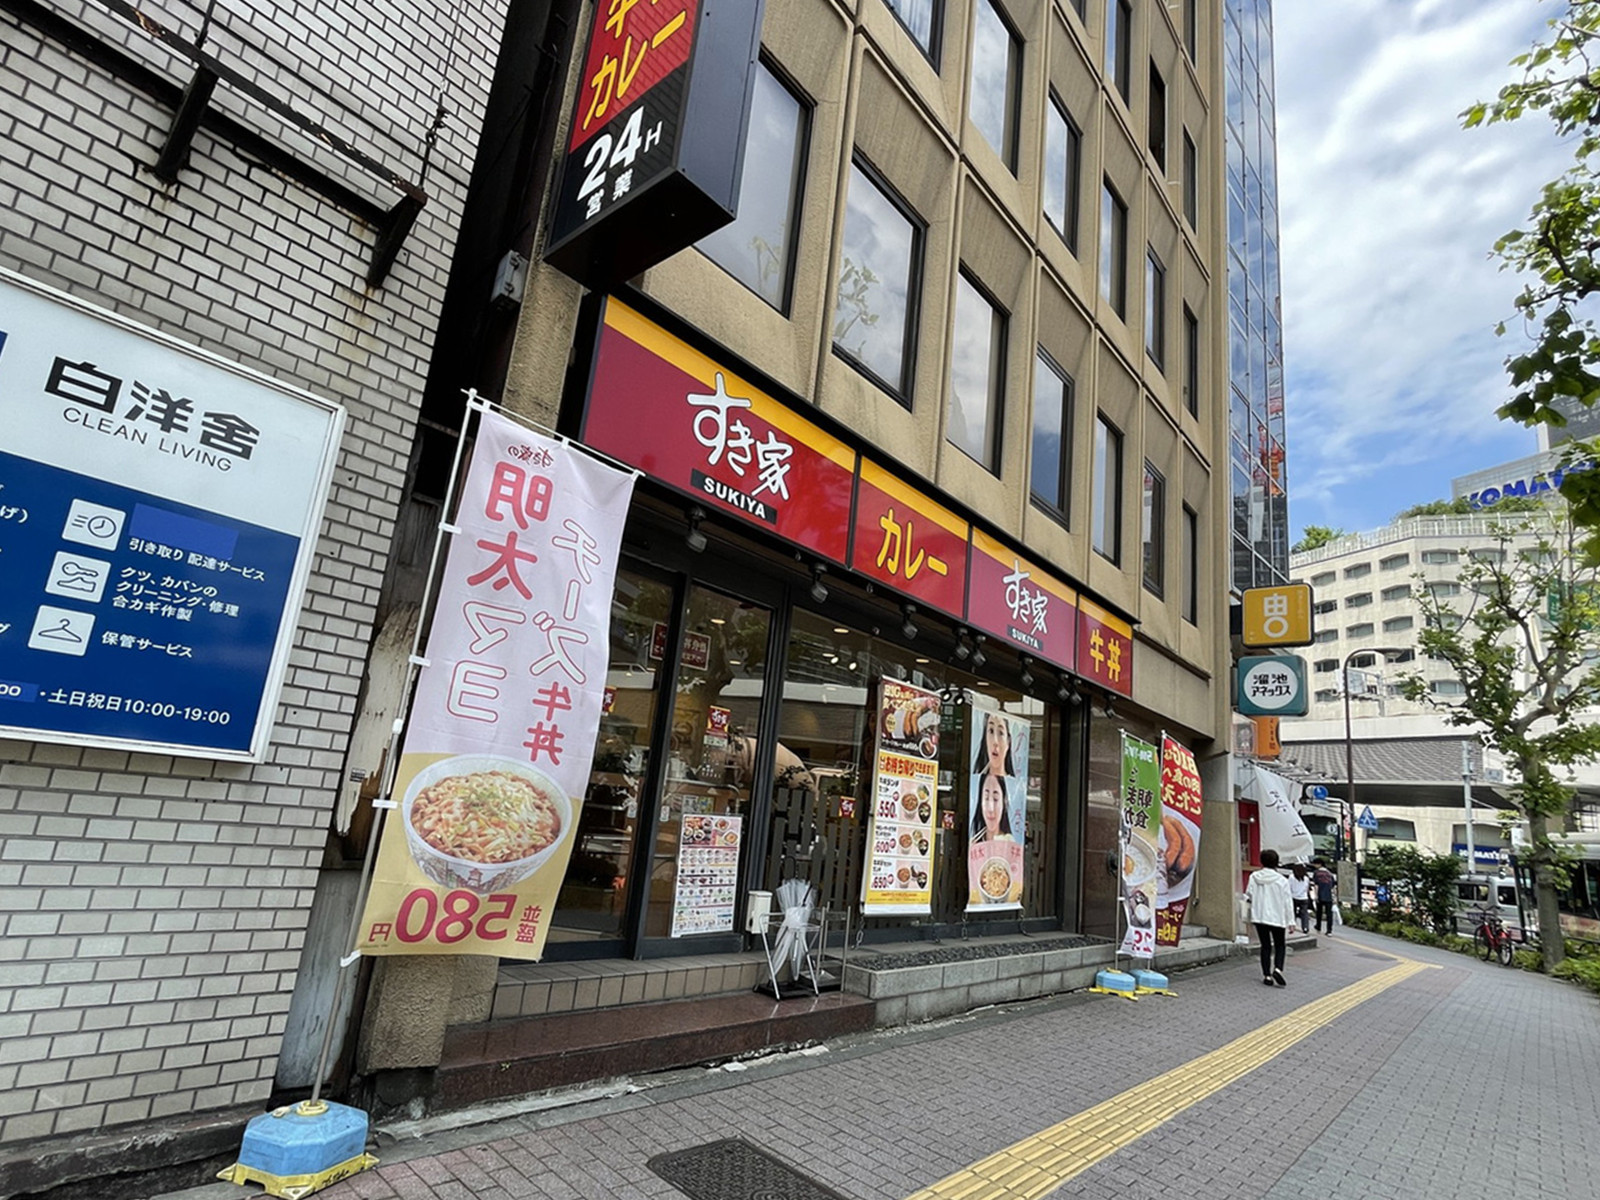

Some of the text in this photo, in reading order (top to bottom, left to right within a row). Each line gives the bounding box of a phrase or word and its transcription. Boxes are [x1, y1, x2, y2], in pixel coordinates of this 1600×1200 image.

[583, 10, 686, 130] カレー
[63, 407, 233, 472] CLEAN LIVING
[687, 372, 794, 500] すき家
[703, 476, 767, 520] SUKIYA
[129, 537, 266, 582] 引き取り 配達サービス
[876, 508, 948, 580] カレー
[116, 580, 240, 618] クリーニング・修理
[120, 566, 219, 598] クツ、カバンの
[1002, 559, 1048, 635] すき家
[112, 594, 194, 622] 合カギ作製
[101, 630, 193, 658] 保管サービス
[1011, 628, 1040, 650] SUKIYA
[1089, 628, 1121, 682] 牛丼
[1251, 684, 1292, 697] アネックス
